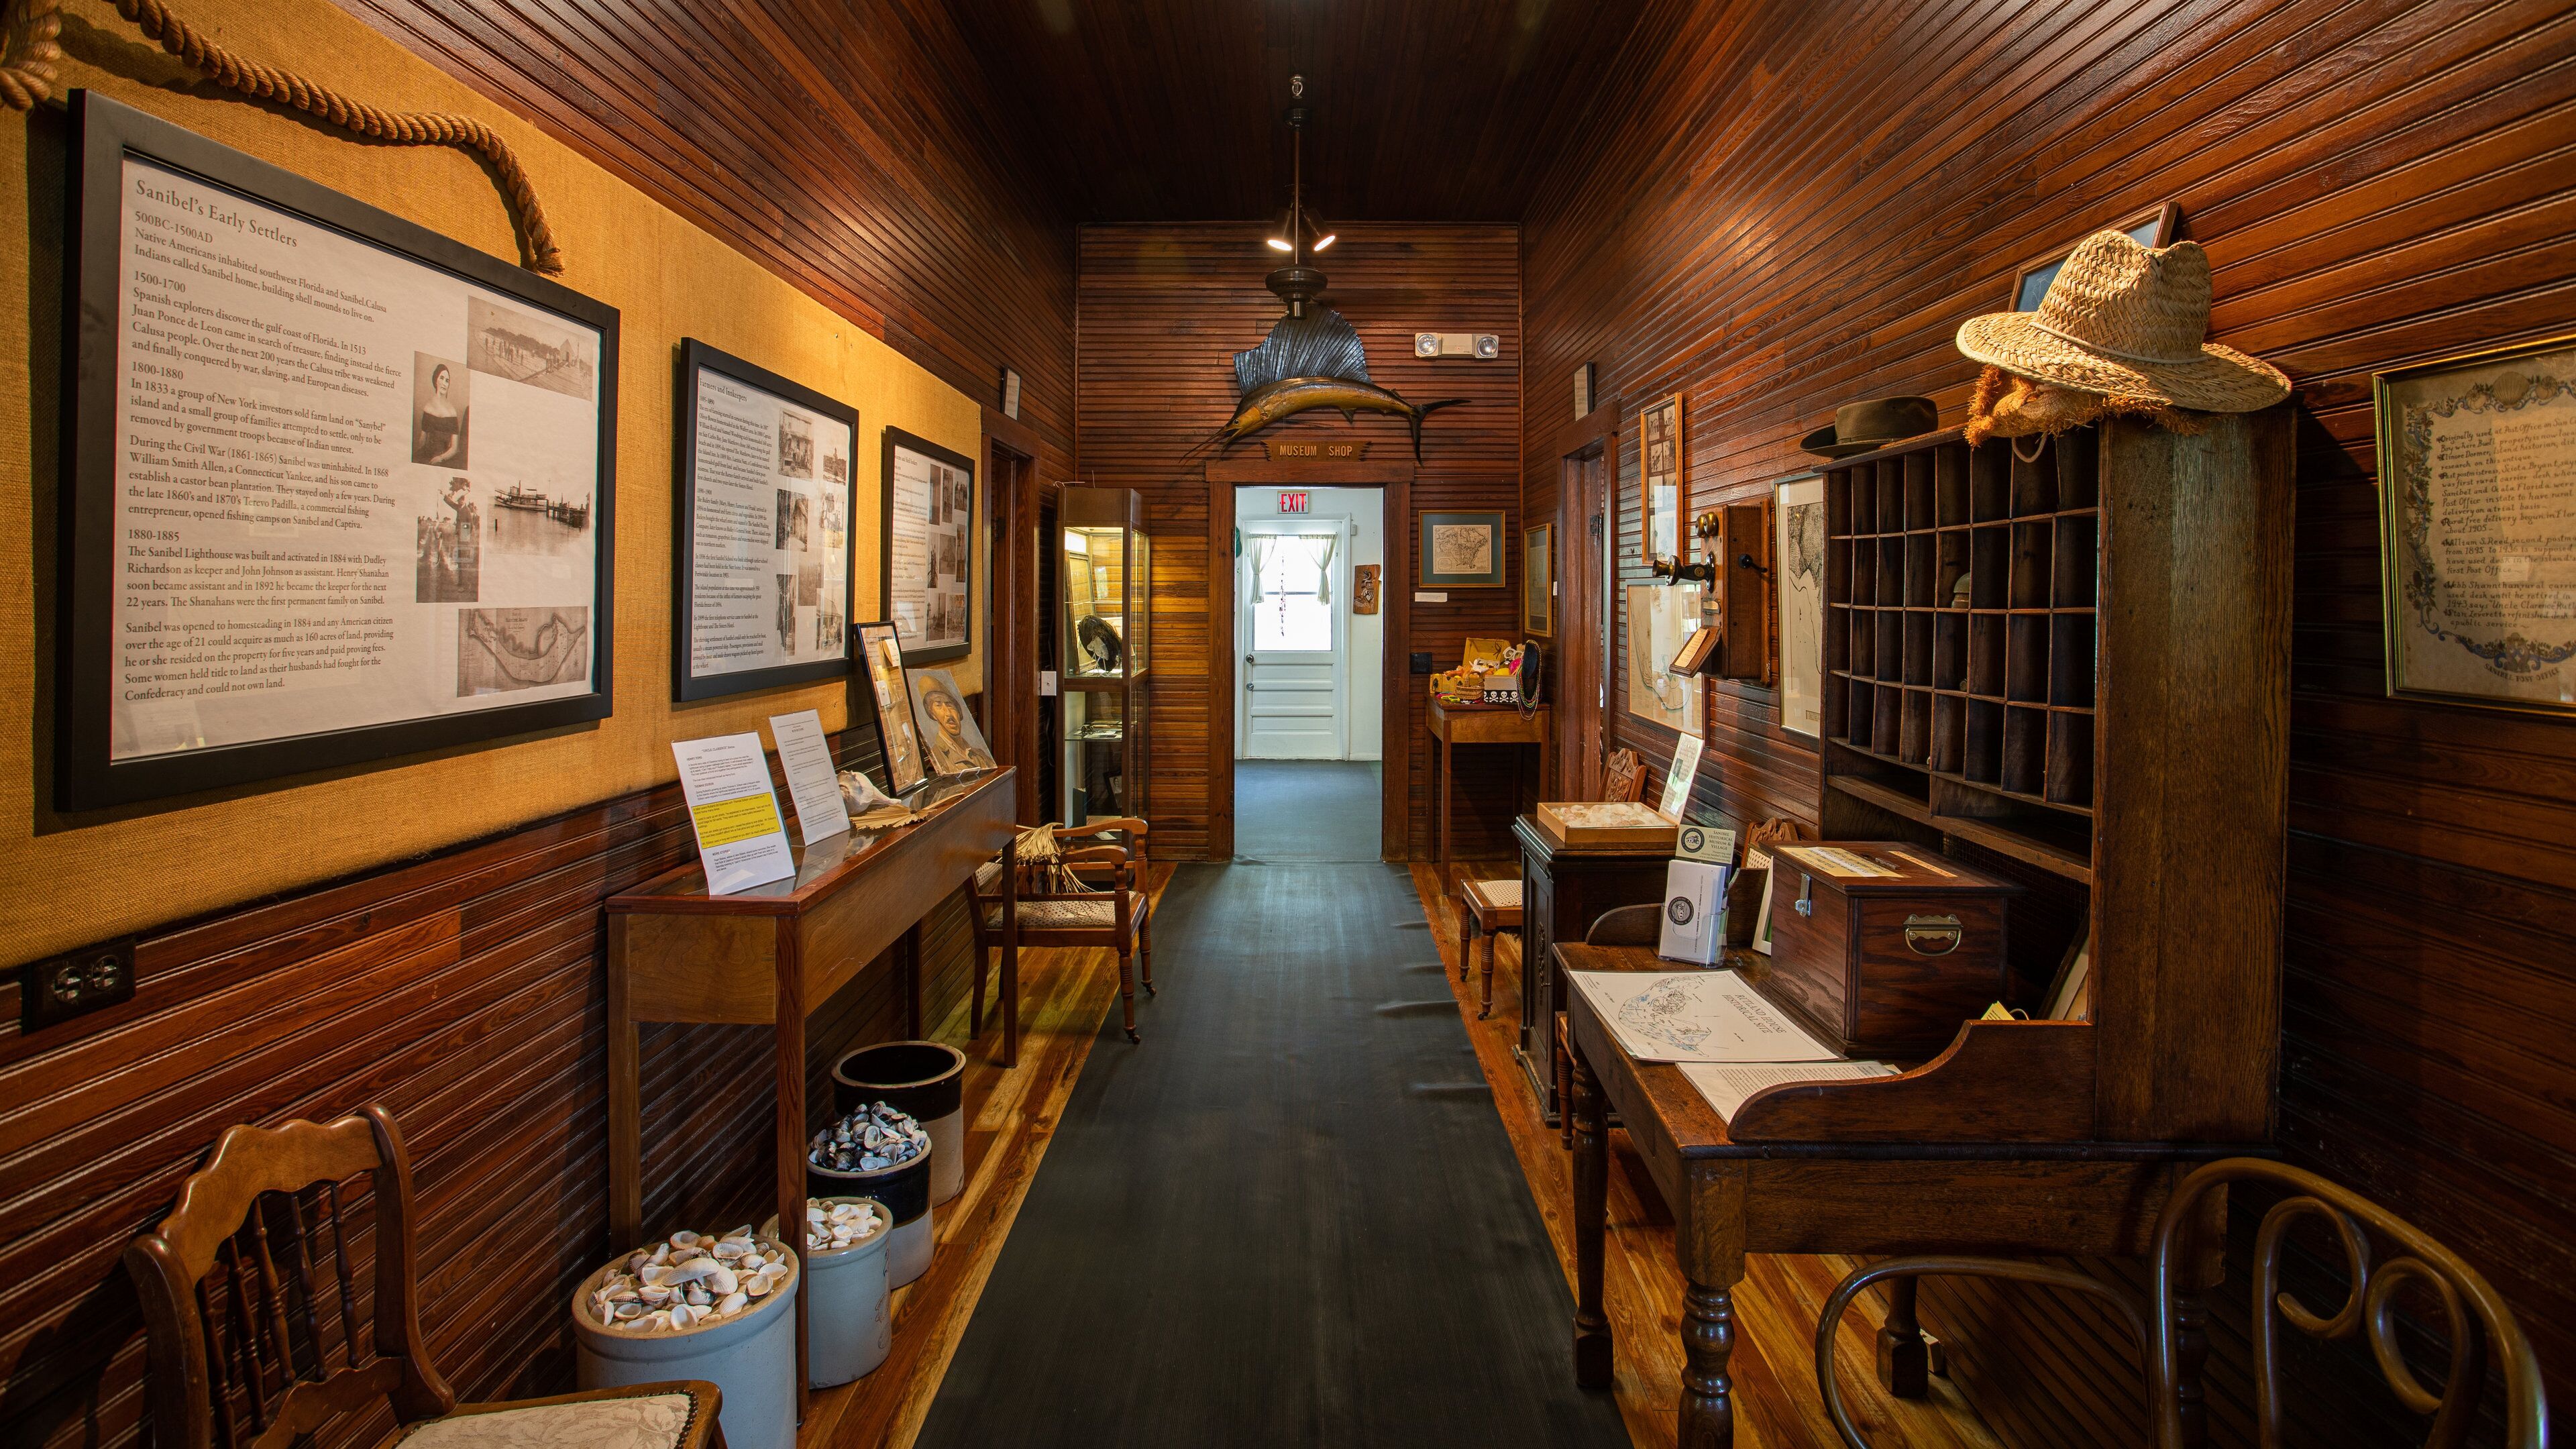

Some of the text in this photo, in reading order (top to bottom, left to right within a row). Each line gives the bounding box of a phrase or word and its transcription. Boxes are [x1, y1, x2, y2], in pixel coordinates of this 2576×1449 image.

[136, 179, 298, 248] Sanibel's Early Settlers
[134, 210, 213, 244] 500BC-1500AD
[135, 227, 167, 246] Native
[168, 238, 217, 261] Americans
[217, 253, 258, 274] inhabited
[259, 268, 298, 286] southwest
[298, 277, 325, 294] Florida
[325, 288, 339, 299] and
[134, 270, 186, 293] 1500-1700
[134, 244, 375, 323] Indians called Sanibel home, building shell mounds to live on.
[131, 321, 395, 390] Calusa people. Over the next 200 years the Calusa tribe was weakened
[132, 361, 184, 380] 1800-1880
[700, 378, 747, 402] Farmers and Innkeepers
[2440, 431, 2473, 445] Originally
[2476, 427, 2492, 437] used
[2519, 423, 2541, 433] Office
[2553, 418, 2567, 427] San
[129, 434, 389, 478] During the Civil War (1861-1865) Sanibel was uninhabited. In 1868
[1280, 445, 1352, 457] MUSEUM SHOP
[2441, 488, 2471, 496] Sanibel
[2517, 480, 2549, 490] Florida
[2442, 497, 2456, 507] Post
[2459, 497, 2480, 508] Office
[2528, 492, 2548, 500] have
[2551, 490, 2572, 498] rural
[1281, 494, 1306, 512] EXIT
[2443, 508, 2474, 518] delivery
[128, 529, 180, 542] 1880-1885
[127, 545, 387, 567] The Sanibel Lighthouse was built and activated in 1884 with Dudley
[2465, 546, 2483, 554] 1895
[2534, 543, 2572, 556] supposed
[125, 596, 140, 608] 22
[140, 599, 168, 610] years.
[170, 596, 188, 607] The
[189, 595, 235, 607] Shanahans
[256, 595, 270, 606] the
[270, 595, 286, 606] first
[287, 598, 327, 608] permanent
[327, 595, 348, 605] family
[359, 595, 385, 605] Sanibel.
[2527, 591, 2559, 599] retired
[125, 616, 394, 635] Sanibel was opened to homesteading in 1884 and any American citizen
[2484, 663, 2512, 681] SANIBEL
[2536, 667, 2559, 681] OFFICE
[124, 677, 286, 702] Confederacy and could not own land.
[1721, 994, 1773, 1034] HISTORICAL SITE
[1735, 994, 1787, 1034] RUTLAND HOUSE
